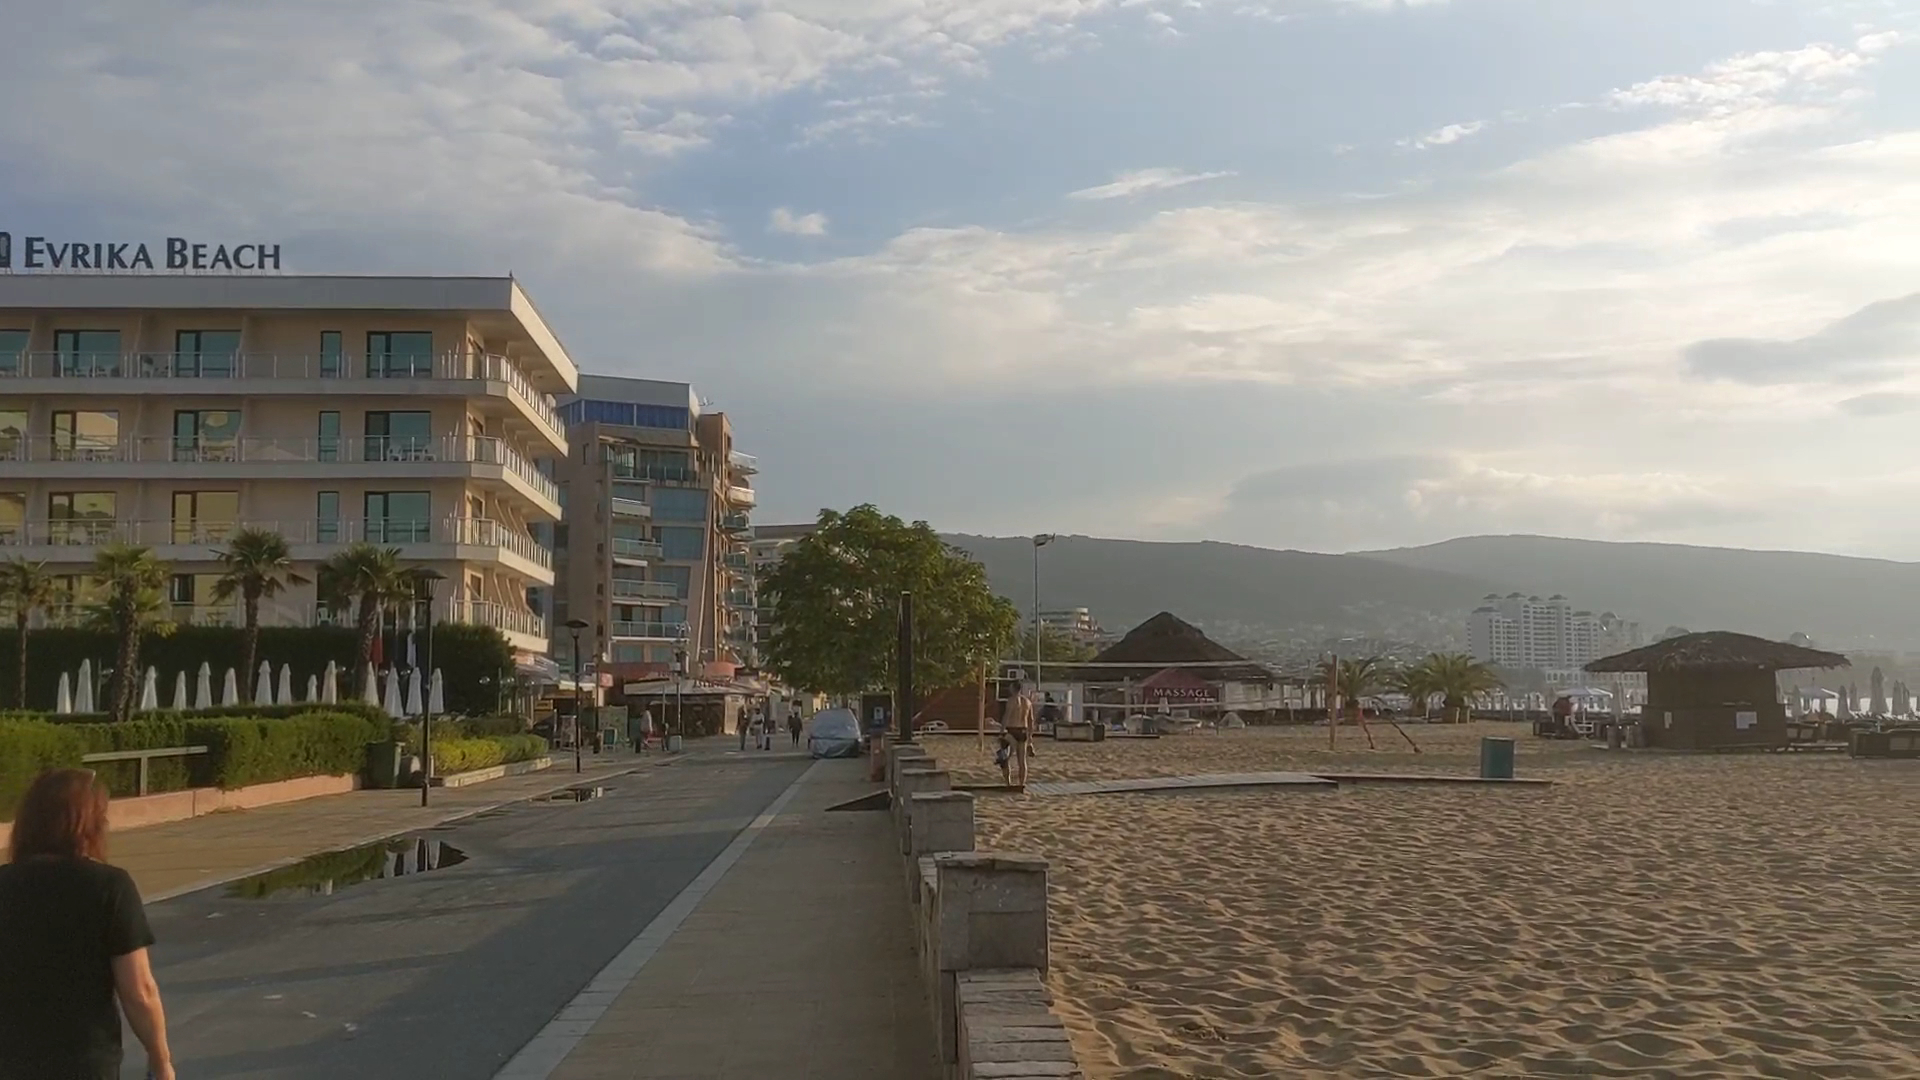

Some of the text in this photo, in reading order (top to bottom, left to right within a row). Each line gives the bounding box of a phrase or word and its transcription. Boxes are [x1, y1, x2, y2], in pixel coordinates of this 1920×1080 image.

[25, 237, 280, 270] EVRIKA BEACH
[1153, 688, 1209, 697] MASSAGE
